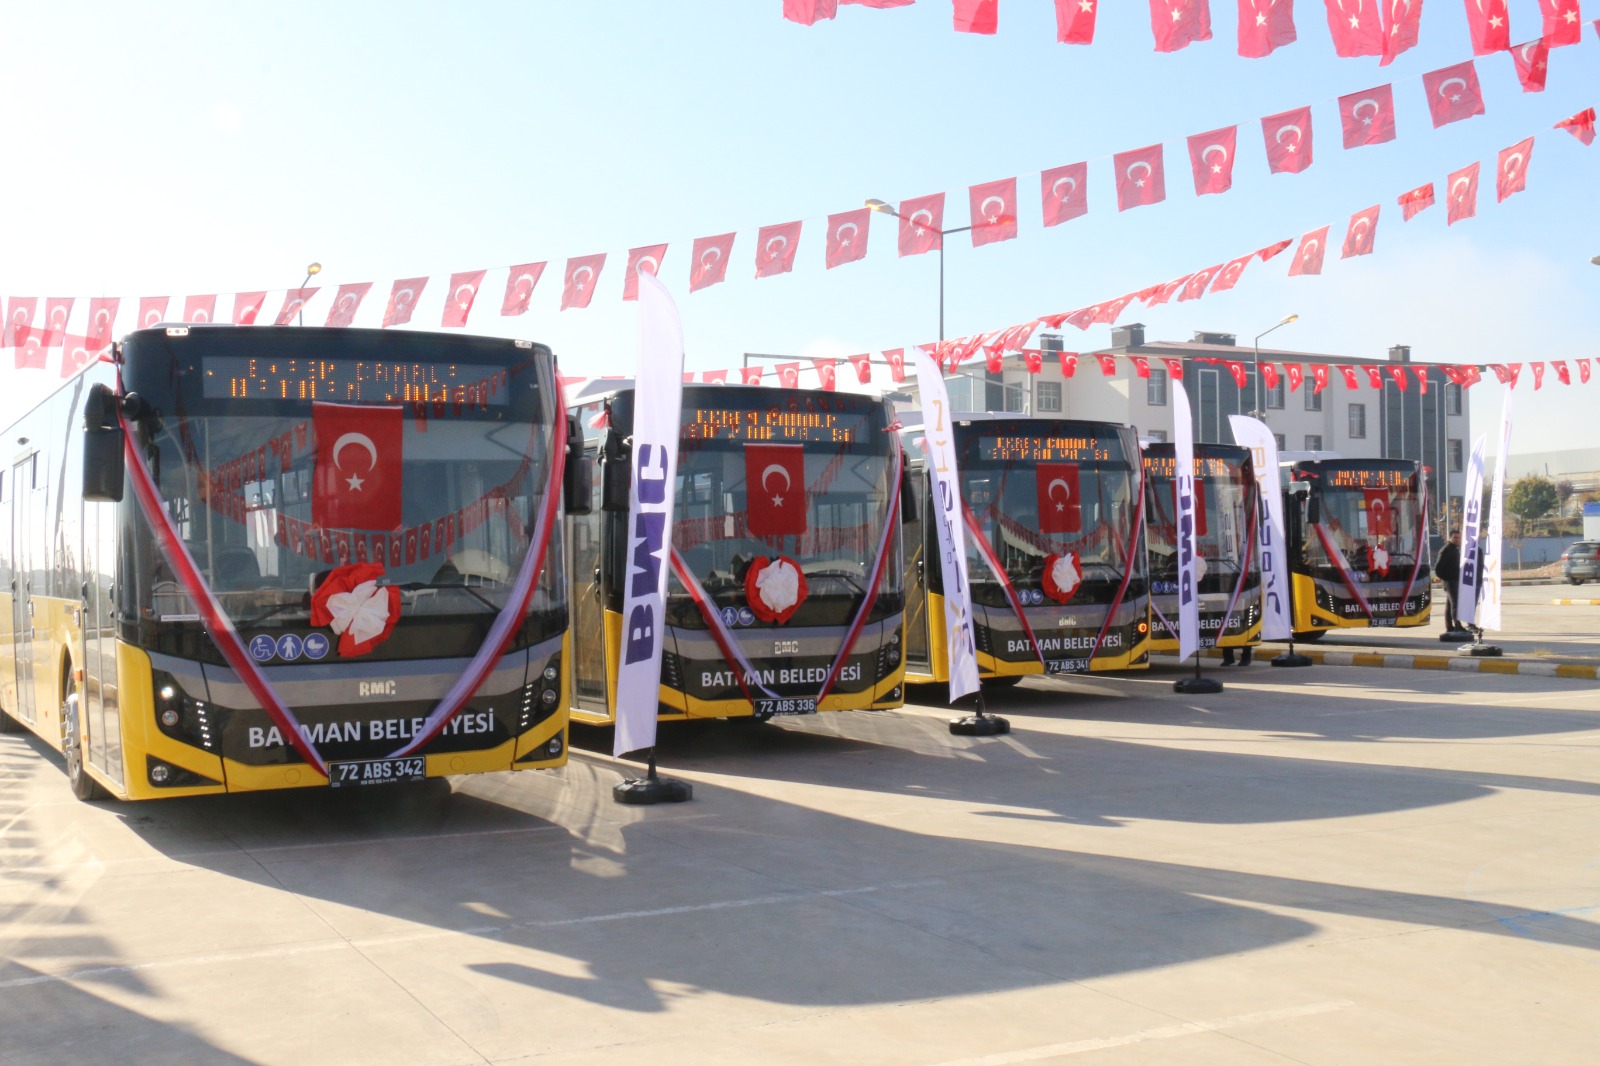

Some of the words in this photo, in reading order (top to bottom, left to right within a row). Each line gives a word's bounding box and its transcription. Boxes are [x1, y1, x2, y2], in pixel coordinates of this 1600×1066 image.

[1462, 499, 1479, 587] BMC
[779, 662, 861, 684] BELEDİESİ
[1060, 660, 1075, 670] ABS
[760, 701, 774, 713] 72
[776, 700, 795, 712] ABS
[797, 699, 815, 711] 336
[249, 721, 361, 748] BAMAN
[339, 764, 359, 781] 72
[363, 762, 392, 779] ABS
[395, 760, 423, 777] 342
